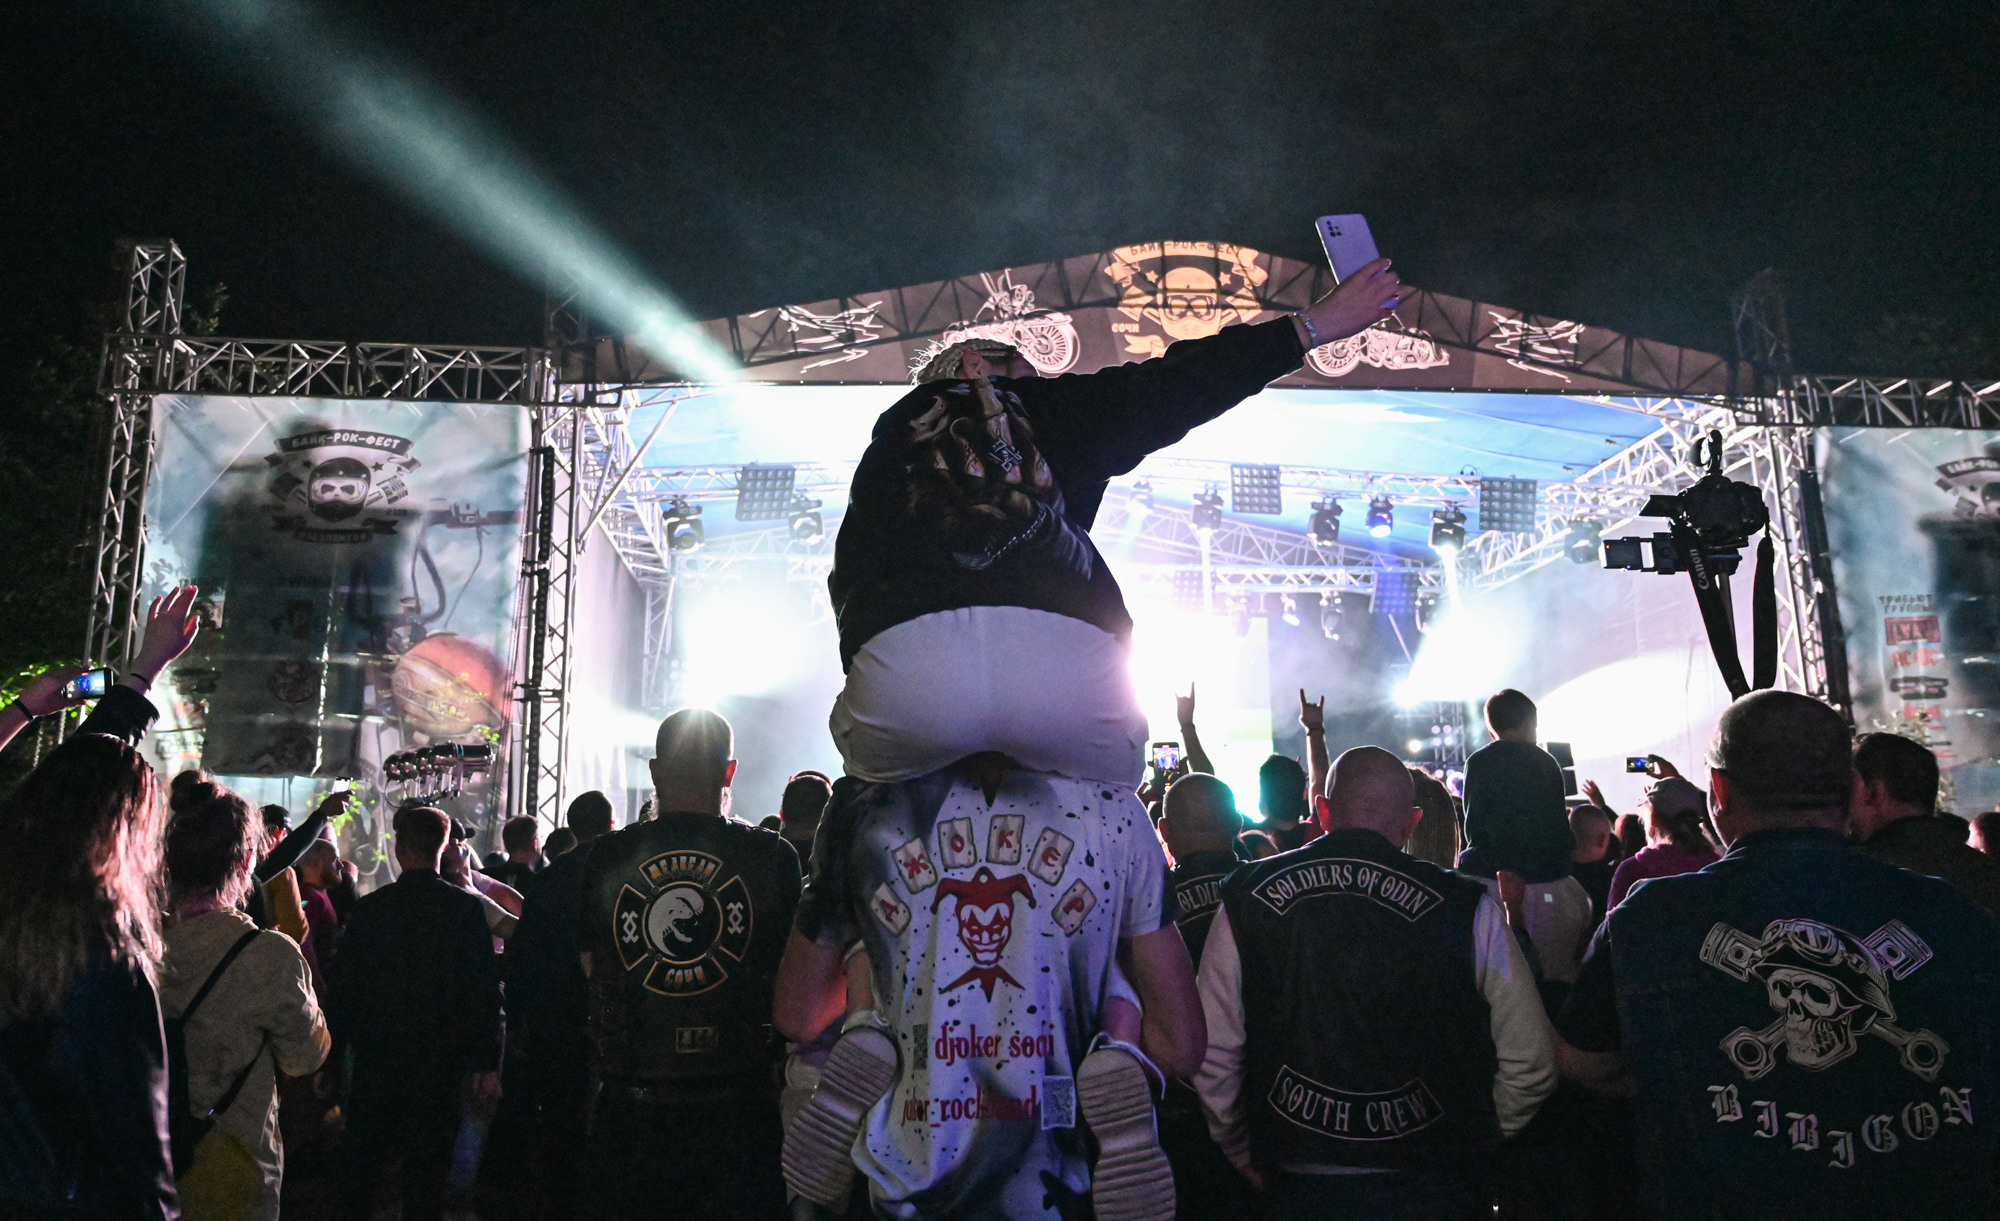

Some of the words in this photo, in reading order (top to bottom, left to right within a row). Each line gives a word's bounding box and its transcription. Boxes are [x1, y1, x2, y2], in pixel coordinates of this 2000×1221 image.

[1111, 322, 1140, 333] СОЧИ
[1690, 549, 1709, 590] Canon
[1176, 881, 1221, 913] OLDIE
[1266, 864, 1353, 907] SOLDIERS
[1357, 866, 1381, 895] OF
[1380, 875, 1430, 915] ODIN
[1277, 1076, 1352, 1132] SOUTH
[1365, 1089, 1429, 1135] CREW
